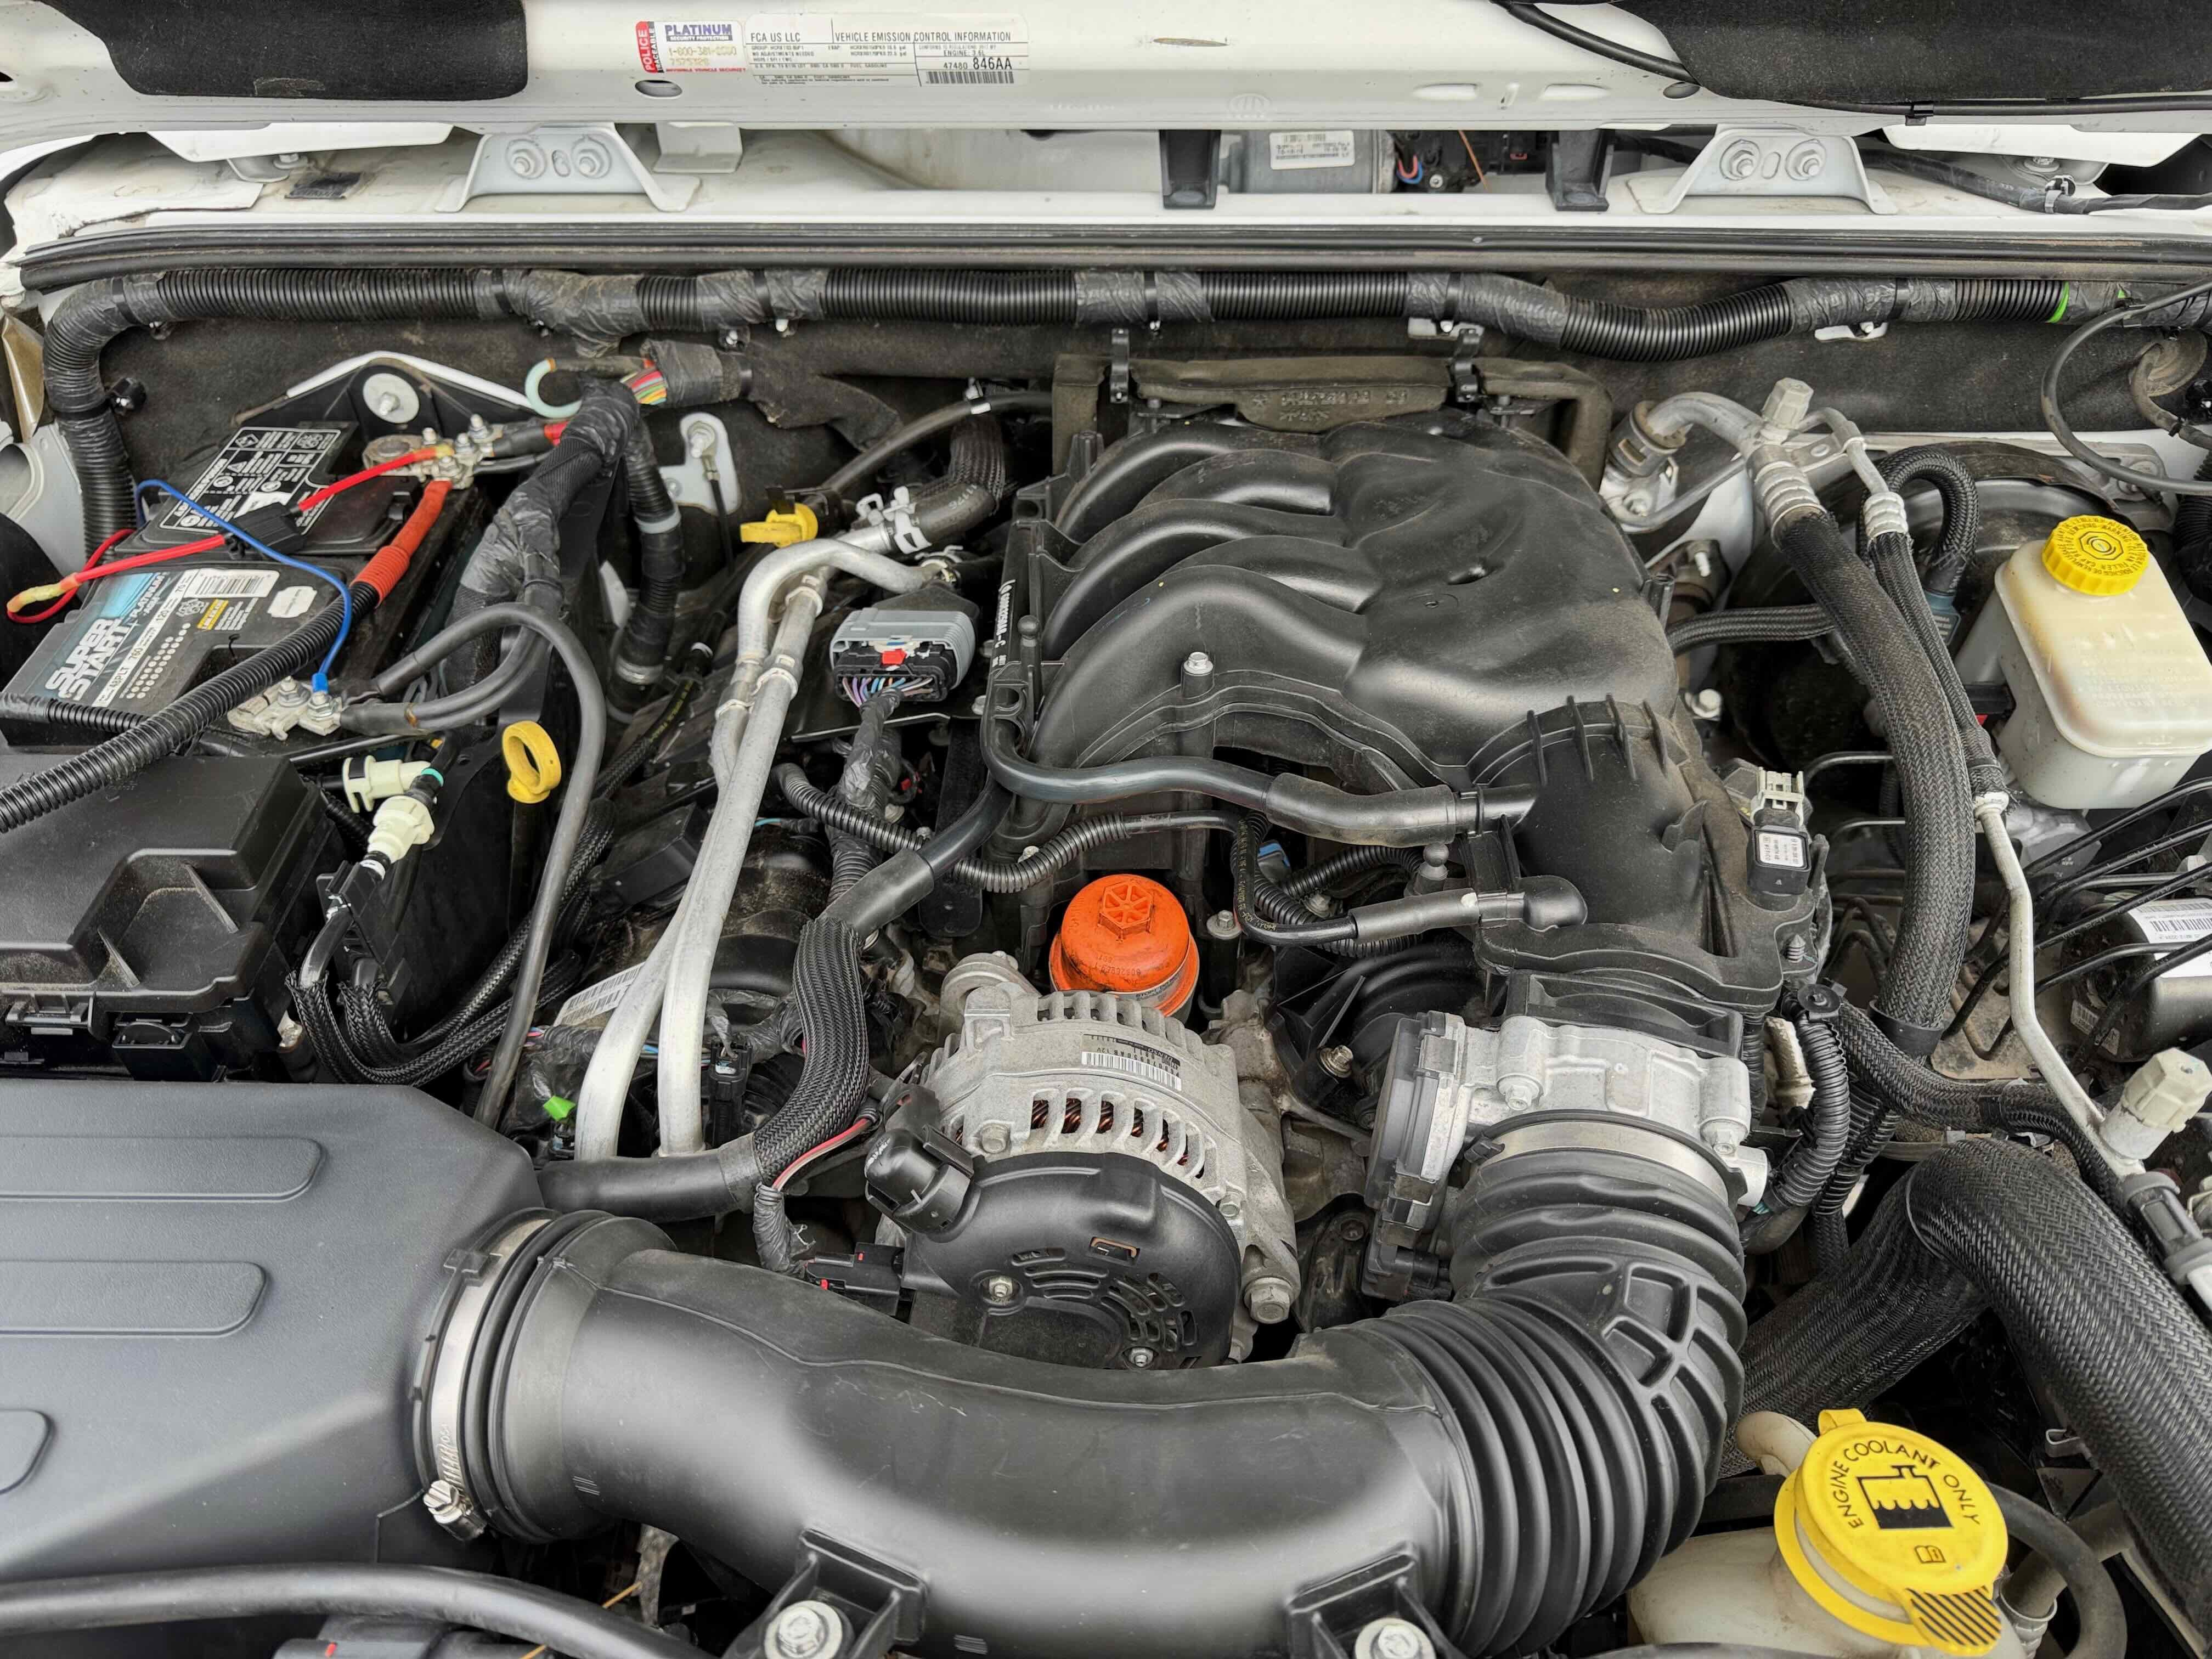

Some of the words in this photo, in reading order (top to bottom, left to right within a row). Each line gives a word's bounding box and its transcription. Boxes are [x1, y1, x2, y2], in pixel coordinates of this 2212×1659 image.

[664, 24, 732, 36] PLATINUM
[751, 33, 767, 42] FCA
[770, 33, 782, 42] US
[785, 33, 800, 42] LLC
[835, 32, 868, 42] VEHICLE
[872, 32, 911, 42] EMISSION
[913, 32, 951, 42] CONTROL
[955, 32, 1011, 42] INFORMATION
[636, 29, 656, 72] POLICE
[973, 57, 1012, 70] 846AA
[2101, 562, 2129, 571] FILLER
[111, 666, 131, 685] 48PLT
[155, 609, 169, 622] 120
[175, 584, 187, 594] 70
[44, 618, 114, 690] SUPER
[58, 618, 131, 701] START
[1148, 1048, 1173, 1063] DENSO
[1843, 1440, 1941, 1470] COOLANT
[1830, 1460, 1864, 1530] ENGINE
[1943, 1474, 1981, 1525] ONLY
